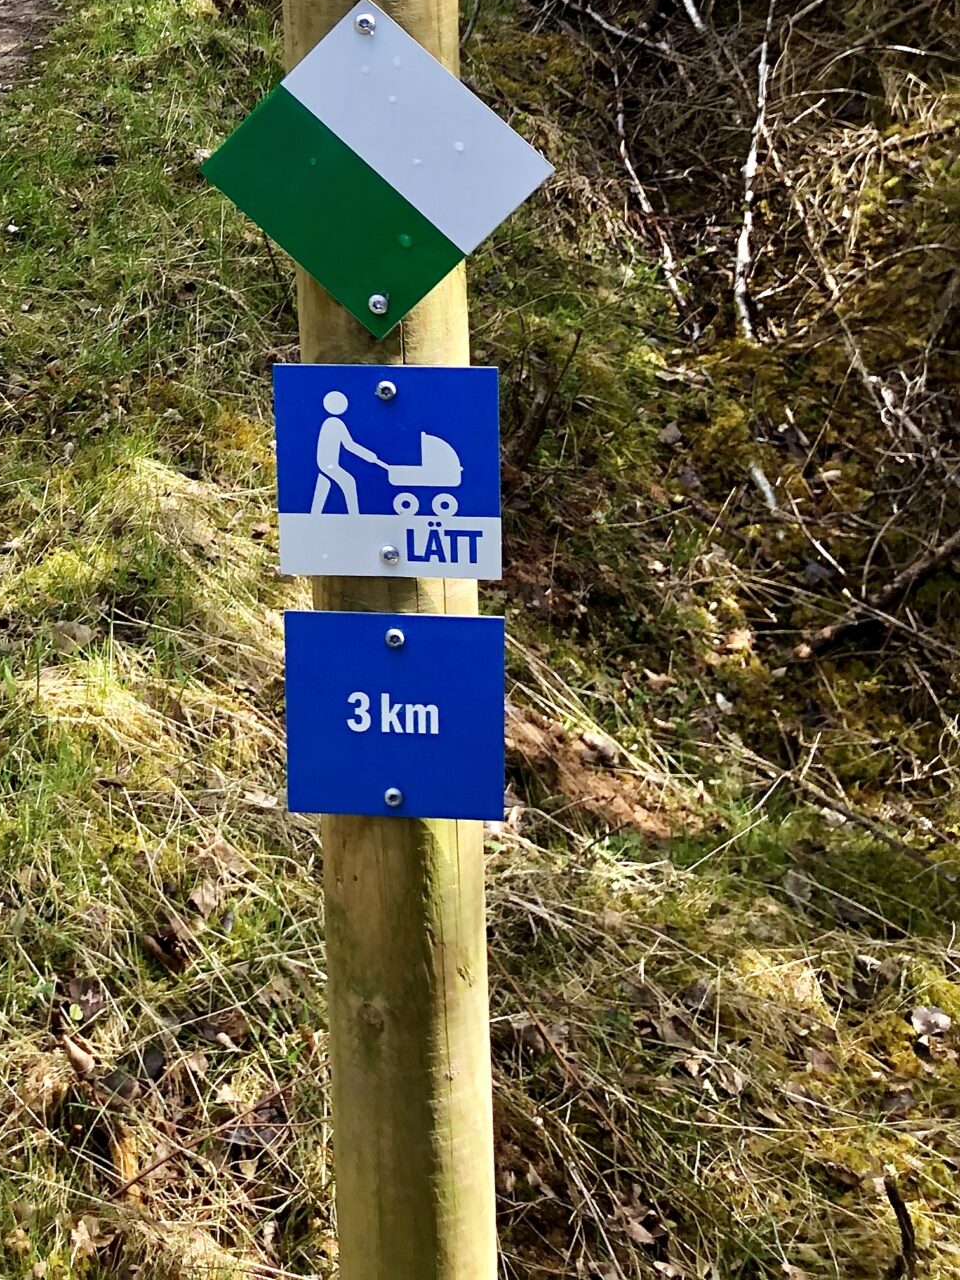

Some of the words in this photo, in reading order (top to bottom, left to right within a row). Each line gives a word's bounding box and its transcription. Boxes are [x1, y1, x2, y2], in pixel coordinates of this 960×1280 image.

[406, 521, 483, 564] LÄTT
[346, 691, 372, 733] 3
[381, 692, 439, 735] km
